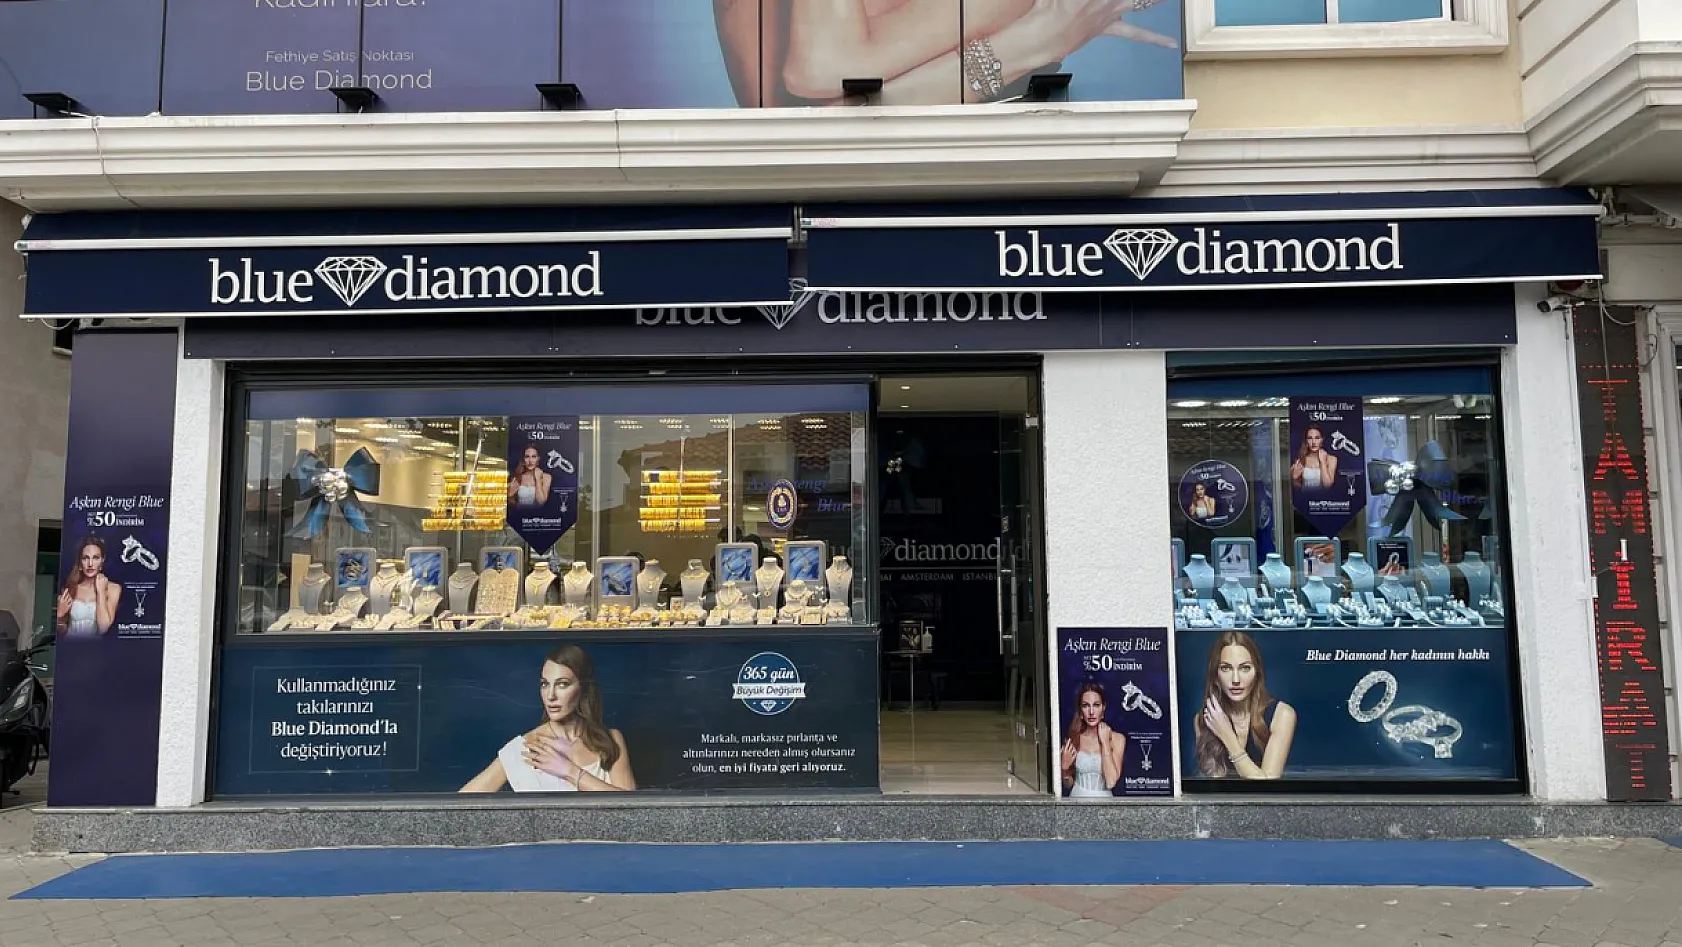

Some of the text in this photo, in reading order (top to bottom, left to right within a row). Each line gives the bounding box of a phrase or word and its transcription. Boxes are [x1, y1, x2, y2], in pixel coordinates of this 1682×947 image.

[266, 50, 318, 65] Fethiye
[246, 69, 432, 91] Blue Diamond
[995, 223, 1404, 277] blue diamond
[208, 250, 604, 304] blue diamond
[69, 495, 164, 511] Aşkın Rengi Blue
[894, 536, 1001, 562] diamond
[1065, 637, 1161, 654] Aşkın Rengi Blue
[1306, 648, 1490, 661] Blue Diamond her kadının hakkı
[742, 665, 795, 683] 365 gün
[277, 677, 396, 695] Kullanmadığınız
[737, 685, 802, 697] Büyük Değişim
[297, 699, 374, 715] takılarınızı
[271, 721, 305, 736] Blue
[741, 733, 784, 744] markasız
[786, 732, 824, 745] pırlanta
[827, 733, 838, 742] ve
[682, 747, 856, 759] altınlarınızı nereden almış olursanız
[691, 761, 846, 774] olun, en iyi fiyata geri alıyoruz.
